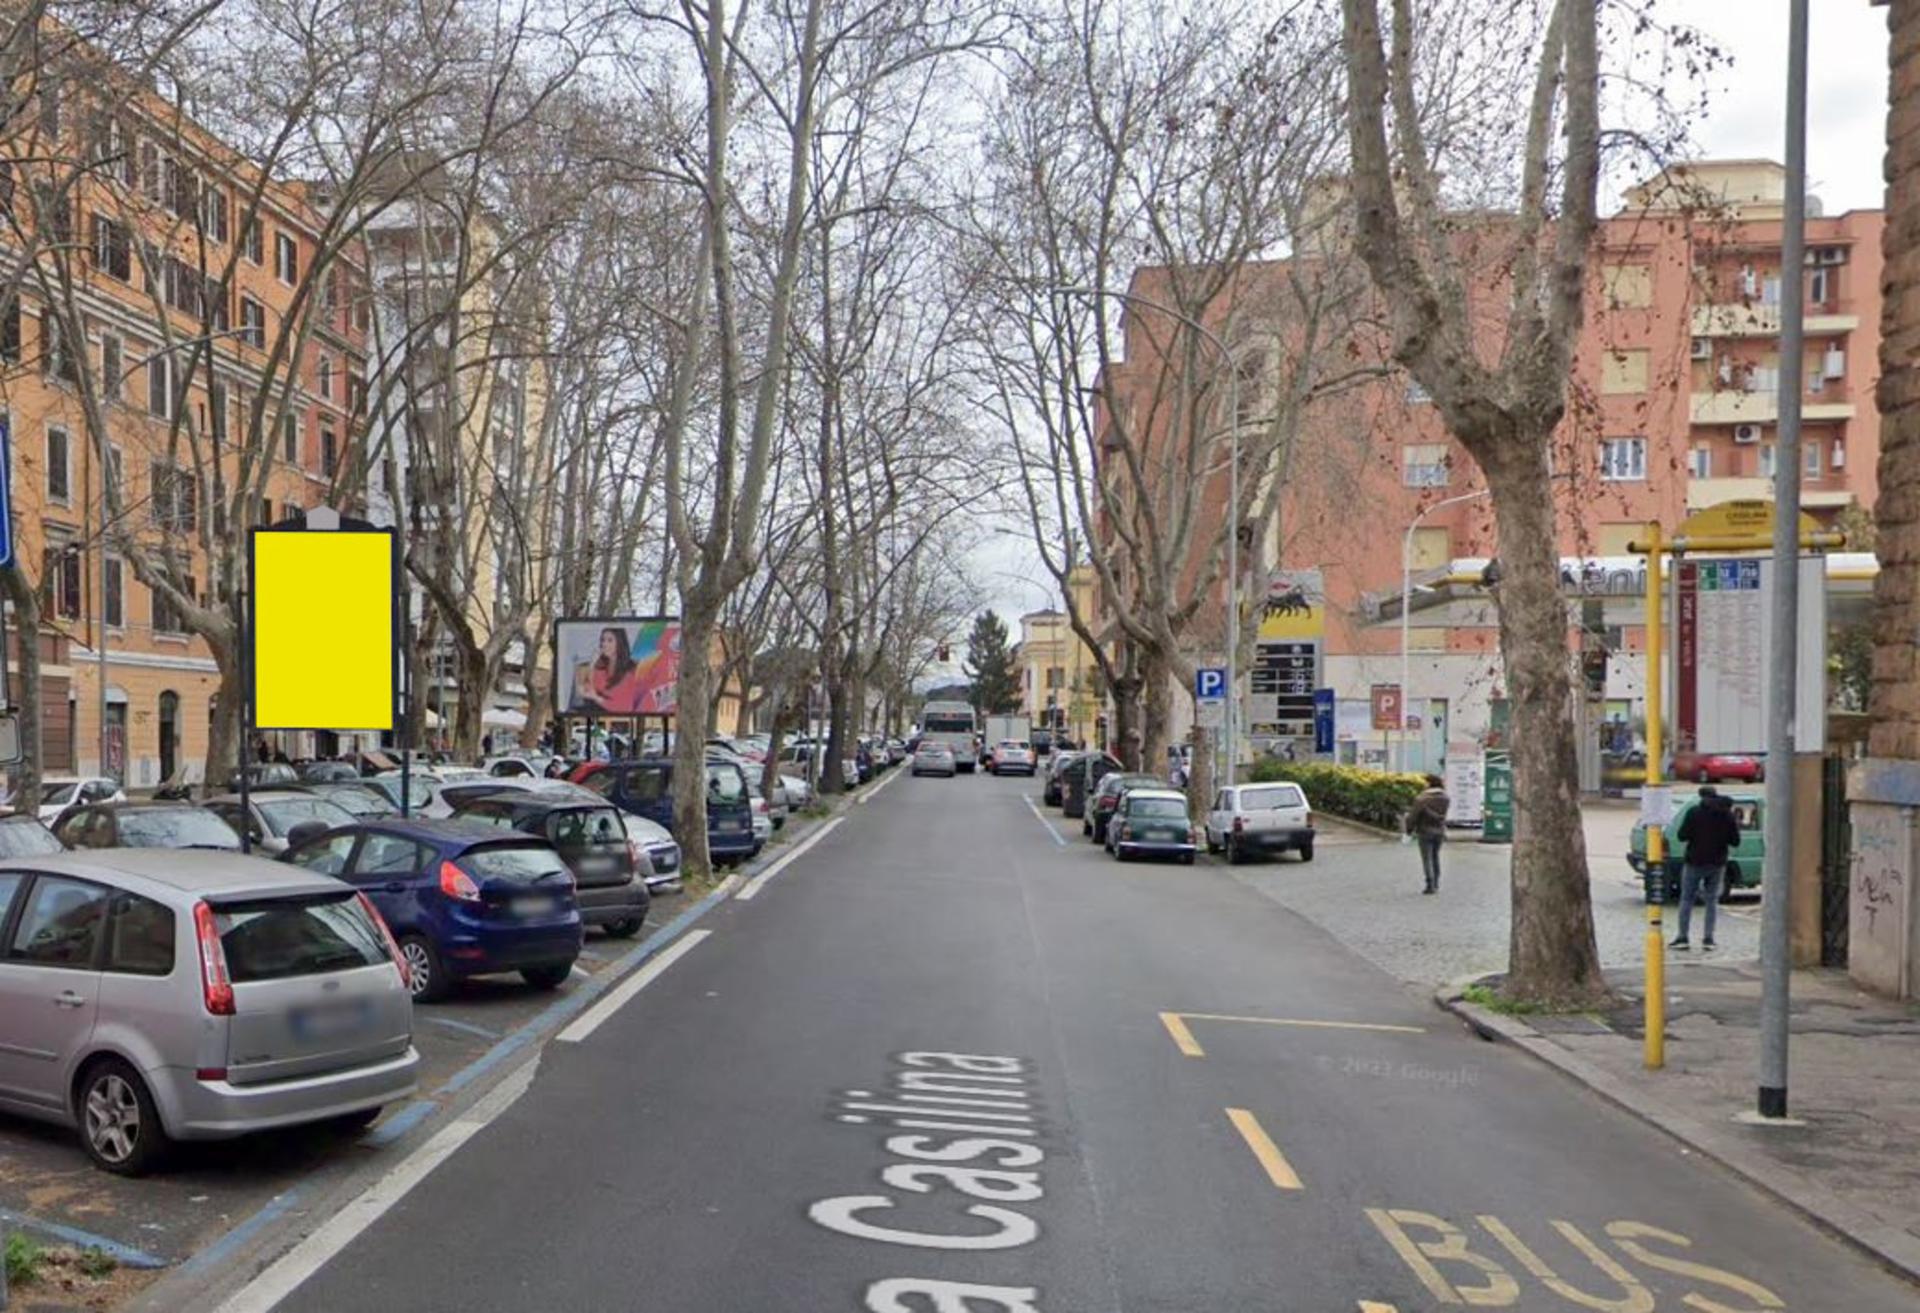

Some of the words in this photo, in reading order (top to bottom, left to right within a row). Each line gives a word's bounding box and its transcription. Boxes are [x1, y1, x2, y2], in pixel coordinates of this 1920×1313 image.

[1202, 671, 1221, 695] P
[1381, 694, 1395, 712] P
[1363, 1207, 1786, 1313] BUS
